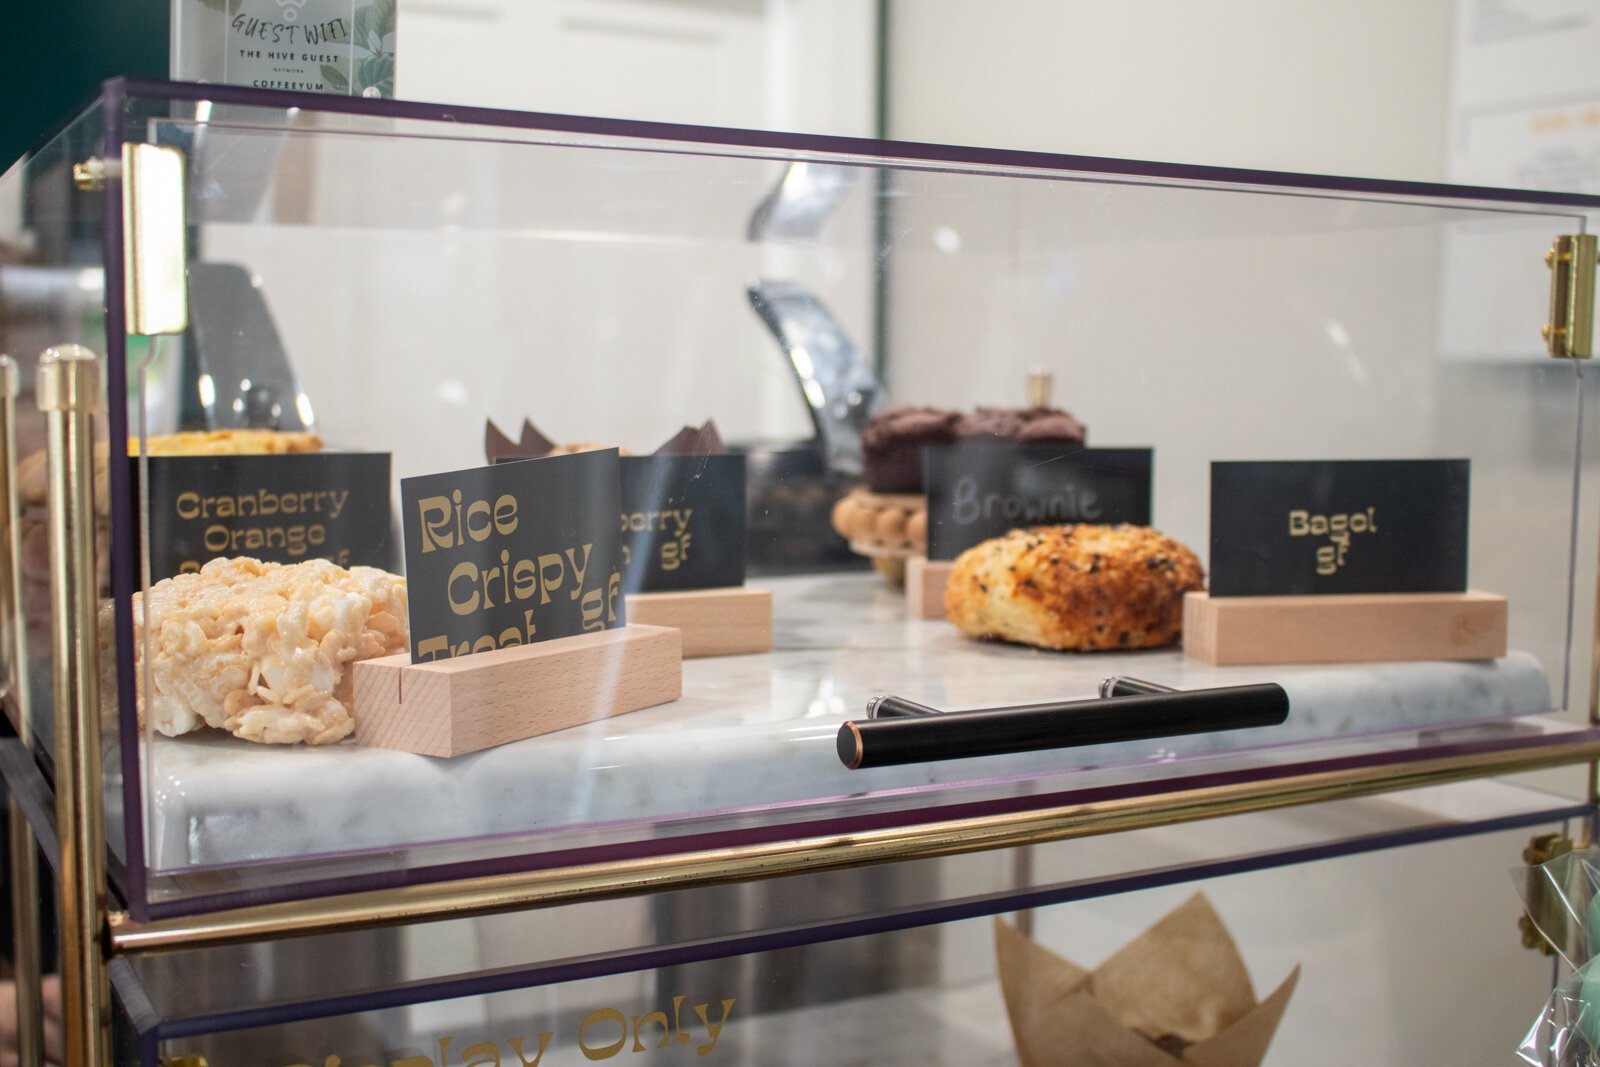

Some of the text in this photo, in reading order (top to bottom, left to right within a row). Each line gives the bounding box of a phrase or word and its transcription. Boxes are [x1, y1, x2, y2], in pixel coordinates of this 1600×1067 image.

[232, 13, 348, 45] GUEST WIFI
[240, 50, 339, 63] THE HIVE GUEST
[253, 80, 324, 91] COFFEEYUM
[176, 488, 349, 520] Cranberry
[952, 474, 1102, 525] Brownie
[204, 523, 325, 556] Orange
[418, 489, 518, 553] Rice
[1289, 507, 1377, 545] Bagel
[448, 543, 593, 616] Crispy
[581, 572, 621, 631] gf
[578, 995, 736, 1062] Only
